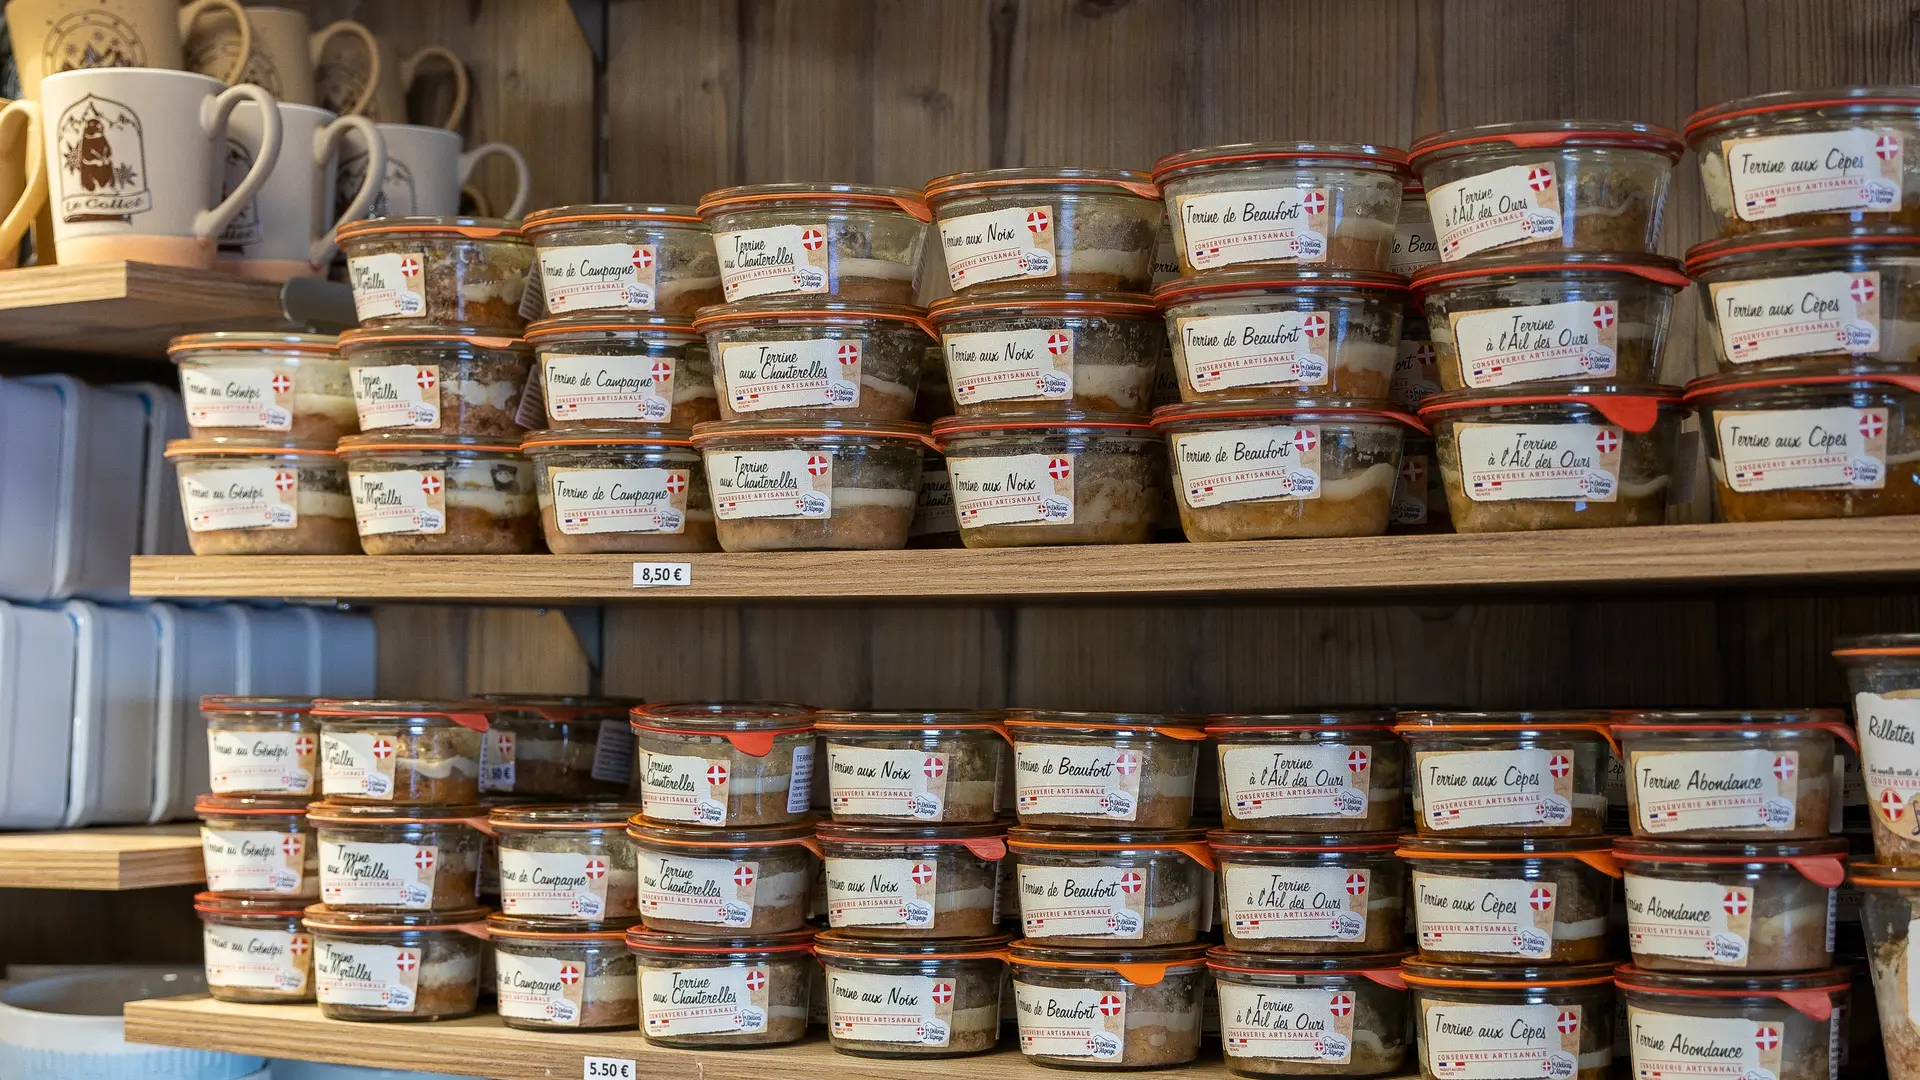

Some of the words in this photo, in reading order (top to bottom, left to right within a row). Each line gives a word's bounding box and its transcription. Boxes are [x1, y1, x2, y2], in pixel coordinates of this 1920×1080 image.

[1742, 154, 1786, 176] Terrine
[1792, 157, 1818, 171] aux
[1825, 148, 1863, 175] Cèpes
[86, 197, 143, 209] Collet
[1458, 188, 1493, 206] Terrine
[1186, 205, 1219, 224] Terrine
[1223, 208, 1237, 224] de
[1242, 200, 1302, 222] Beaufort
[1445, 215, 1451, 226] à
[1453, 203, 1475, 225] l'Ail
[1478, 203, 1492, 219] des
[1498, 195, 1528, 215] Ours
[734, 236, 765, 252] Terrine
[966, 235, 982, 246] aux
[987, 223, 1015, 242] Noix
[1195, 237, 1240, 250] CONSERVERIE
[1243, 230, 1295, 241] ARTISANALE
[737, 246, 794, 268] Chanterelles
[566, 265, 576, 277] de
[580, 260, 635, 282] Campagne
[1727, 297, 1763, 317] Terrine
[1768, 302, 1793, 316] aux
[1800, 292, 1840, 319] Cèpes
[1511, 315, 1554, 333] Terrine
[1187, 328, 1219, 346] Terrine
[1223, 331, 1236, 346] de
[1242, 325, 1301, 345] Beaufort
[1486, 340, 1492, 351] à
[1499, 332, 1530, 351] l'Ail
[1534, 334, 1550, 350] des
[1559, 330, 1588, 347] Ours
[759, 347, 798, 365] Terrine
[951, 344, 976, 362] Terrine
[980, 350, 999, 362] aux
[1004, 342, 1035, 362] Noix
[1472, 353, 1526, 369] CONSERVERIE
[1530, 347, 1583, 360] ARTISANALE
[739, 370, 756, 379] aux
[760, 361, 828, 380] Chanterelles
[1196, 360, 1240, 372] CONSERVERIE
[1243, 354, 1295, 365] ARTISANALE
[549, 366, 578, 385] Terrine
[580, 375, 591, 386] de
[596, 370, 652, 392] Campagne
[781, 380, 830, 390] ARTISANALE
[993, 371, 1040, 381] ARTISANALE
[363, 383, 398, 404] Myrtilles
[1515, 433, 1557, 451] Terrine
[1730, 426, 1770, 448] Terrine
[1776, 435, 1801, 448] aux
[1808, 426, 1846, 451] Cèpes
[1181, 442, 1211, 463] Terrine
[1216, 445, 1228, 463] de
[1234, 440, 1292, 461] Beaufort
[1488, 456, 1494, 466] à
[1501, 449, 1530, 468] l'Ail
[1535, 453, 1551, 468] des
[1560, 451, 1590, 468] Ours
[734, 456, 768, 473] Terrine
[1235, 469, 1286, 479] ARTISANALE
[1473, 472, 1527, 481] CONSERVERIE
[1531, 468, 1583, 478] ARTISANALE
[720, 477, 733, 488] aux
[736, 472, 798, 489] Chanterelles
[955, 473, 979, 491] Terrine
[983, 481, 1001, 492] aux
[1006, 473, 1036, 491] Noix
[367, 489, 402, 509] Myrtilles
[557, 481, 589, 500] Terrine
[593, 488, 604, 500] de
[610, 483, 668, 506] Campagne
[610, 507, 657, 516] ARTISANALE
[642, 567, 670, 582] 8,50
[674, 568, 682, 581] €
[1869, 715, 1915, 744] Rillettes
[647, 753, 672, 773] Terrine
[857, 765, 876, 777] aux
[881, 761, 910, 779] Noix
[1043, 761, 1053, 774] de
[1059, 757, 1115, 777] Beaufort
[1273, 753, 1313, 770] Terrine
[646, 771, 695, 792] Chanterelles
[1249, 772, 1256, 786] à
[1259, 767, 1288, 786] l'Ail
[1292, 772, 1307, 787] des
[1316, 771, 1343, 786] Ours
[1430, 767, 1467, 787] Terrine
[1473, 775, 1497, 786] aux
[1504, 766, 1539, 792] Cèpes
[1643, 769, 1680, 789] Terrine
[1687, 770, 1762, 791] Abondance
[1236, 791, 1284, 801] CONSERVERIE
[1287, 788, 1338, 796] ARTISANALE
[1432, 801, 1482, 811] CONSERVERIE
[1485, 794, 1540, 804] ARTISANALE
[1648, 801, 1700, 812] CONSERVERIE
[1706, 797, 1762, 807] ARTISANALE
[342, 856, 389, 879] Myrtilles
[660, 859, 693, 879] Terrine
[532, 868, 586, 889] Campagne
[660, 874, 721, 897] Chanterelles
[848, 881, 865, 892] aux
[870, 875, 898, 893] Noix
[1048, 883, 1058, 896] de
[1064, 878, 1119, 898] Beaufort
[1271, 875, 1310, 892] Terrine
[1247, 893, 1254, 905] à
[1258, 888, 1285, 908] l'Ail
[1289, 895, 1304, 910] des
[1312, 892, 1341, 909] Ours
[1420, 886, 1448, 907] Terrine
[1452, 898, 1474, 911] aux
[1481, 892, 1516, 919] Cèpes
[1647, 897, 1711, 922] Abondance
[329, 957, 372, 980] Myrtilles
[514, 971, 562, 994] Campagne
[672, 972, 710, 988] Terrine
[653, 994, 668, 1003] aux
[671, 986, 737, 1005] Chanterelles
[833, 978, 858, 1000] Terrine
[862, 991, 882, 1004] aux
[887, 989, 917, 1006] Noix
[691, 1006, 738, 1016] ARTISANALE
[1047, 1000, 1098, 1019] Beaufort
[1257, 994, 1293, 1012] Terrine
[1236, 1012, 1242, 1024] à
[1246, 1008, 1271, 1027] l'Ail
[1274, 1015, 1288, 1030] des
[1296, 1014, 1324, 1030] Ours
[1435, 1013, 1473, 1036] Terrine
[1478, 1026, 1502, 1038] aux
[1510, 1018, 1546, 1045] Cèpes
[1635, 1025, 1665, 1050] Terrine
[1670, 1033, 1742, 1058] Abondance
[1492, 1051, 1546, 1059] ARTISANALE
[589, 1063, 617, 1077] 5.50
[621, 1064, 629, 1077] €
